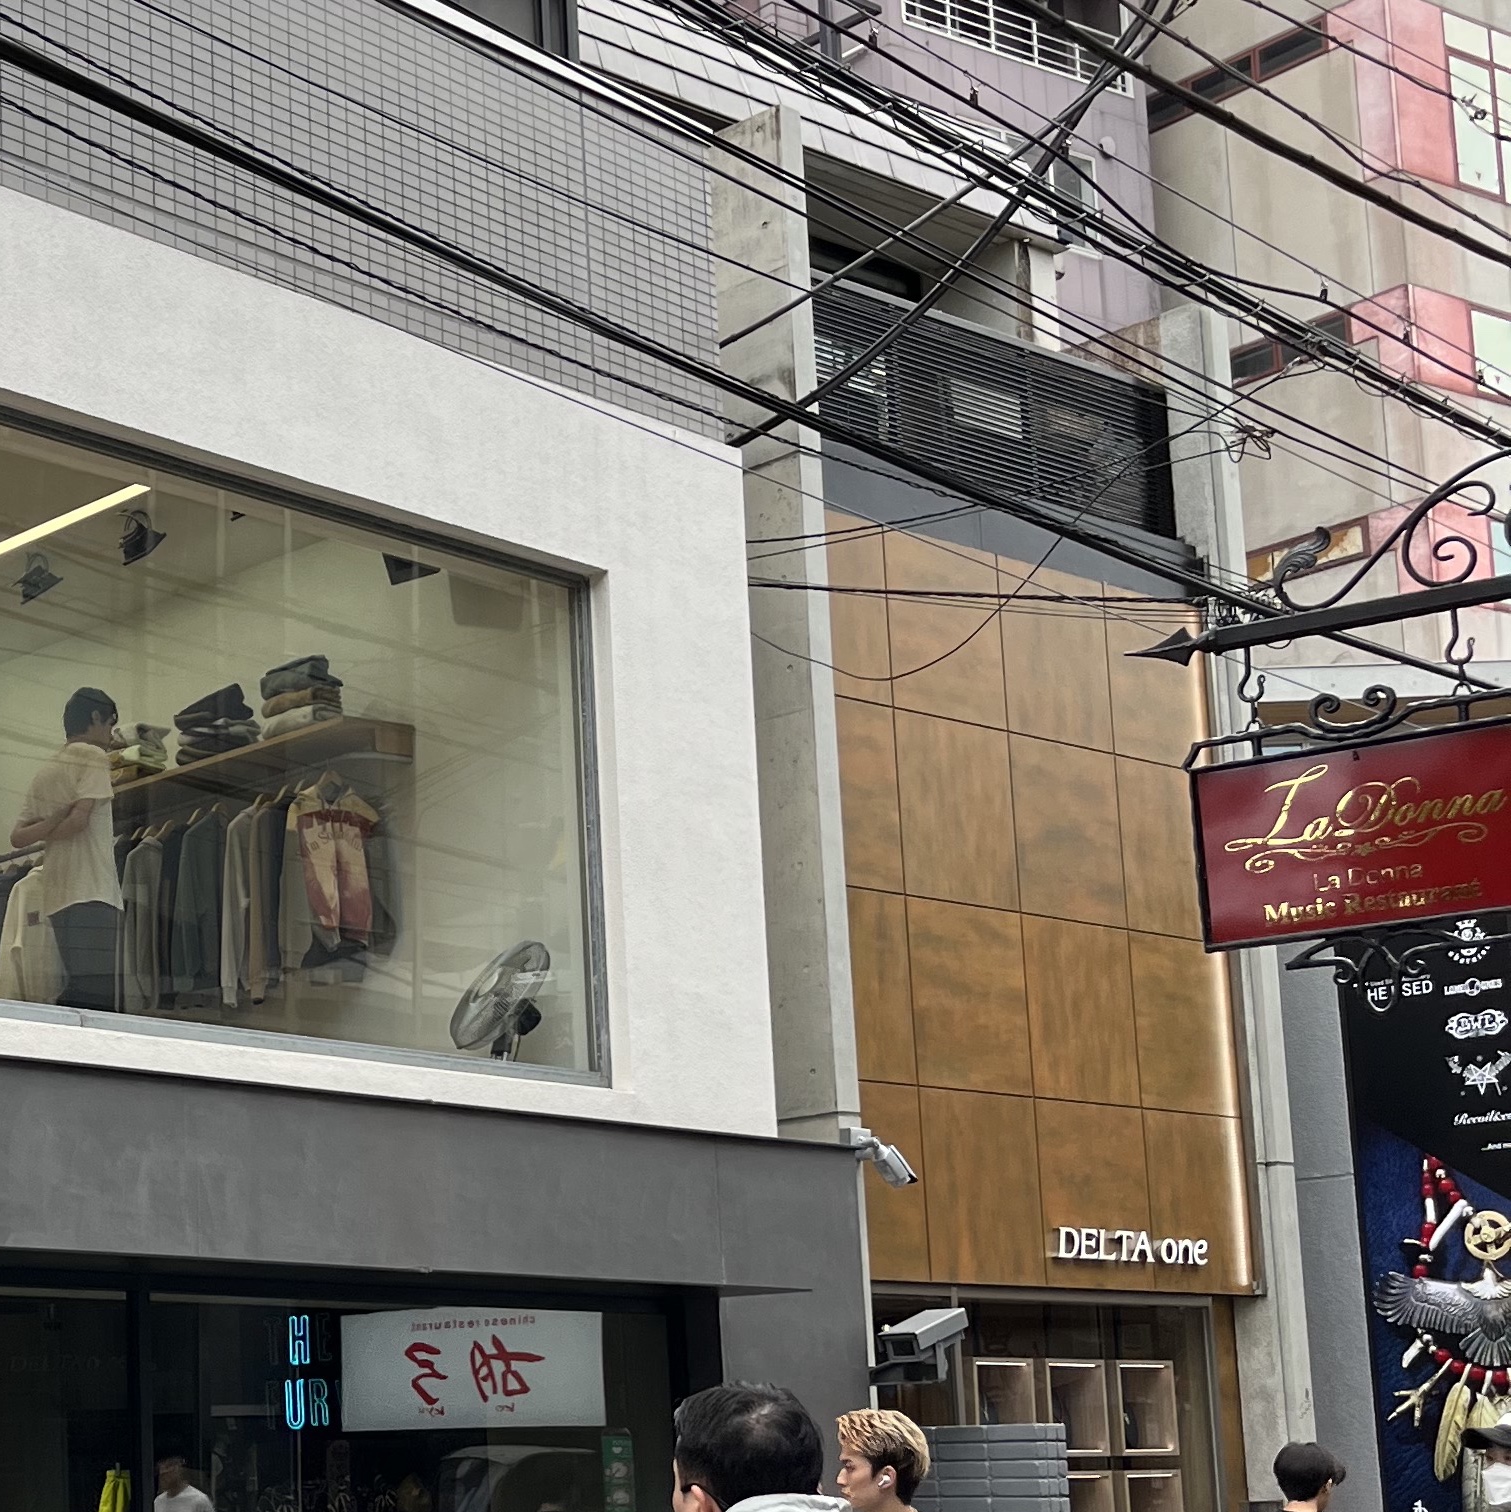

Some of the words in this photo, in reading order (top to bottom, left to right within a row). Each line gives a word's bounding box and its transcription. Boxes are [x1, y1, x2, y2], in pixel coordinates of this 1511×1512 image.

[1335, 776, 1508, 838] Donna
[1313, 871, 1342, 892] La
[1347, 861, 1424, 887] Donna
[1263, 897, 1337, 928] Music
[1058, 1226, 1156, 1263] DELTA
[1160, 1237, 1209, 1266] one
